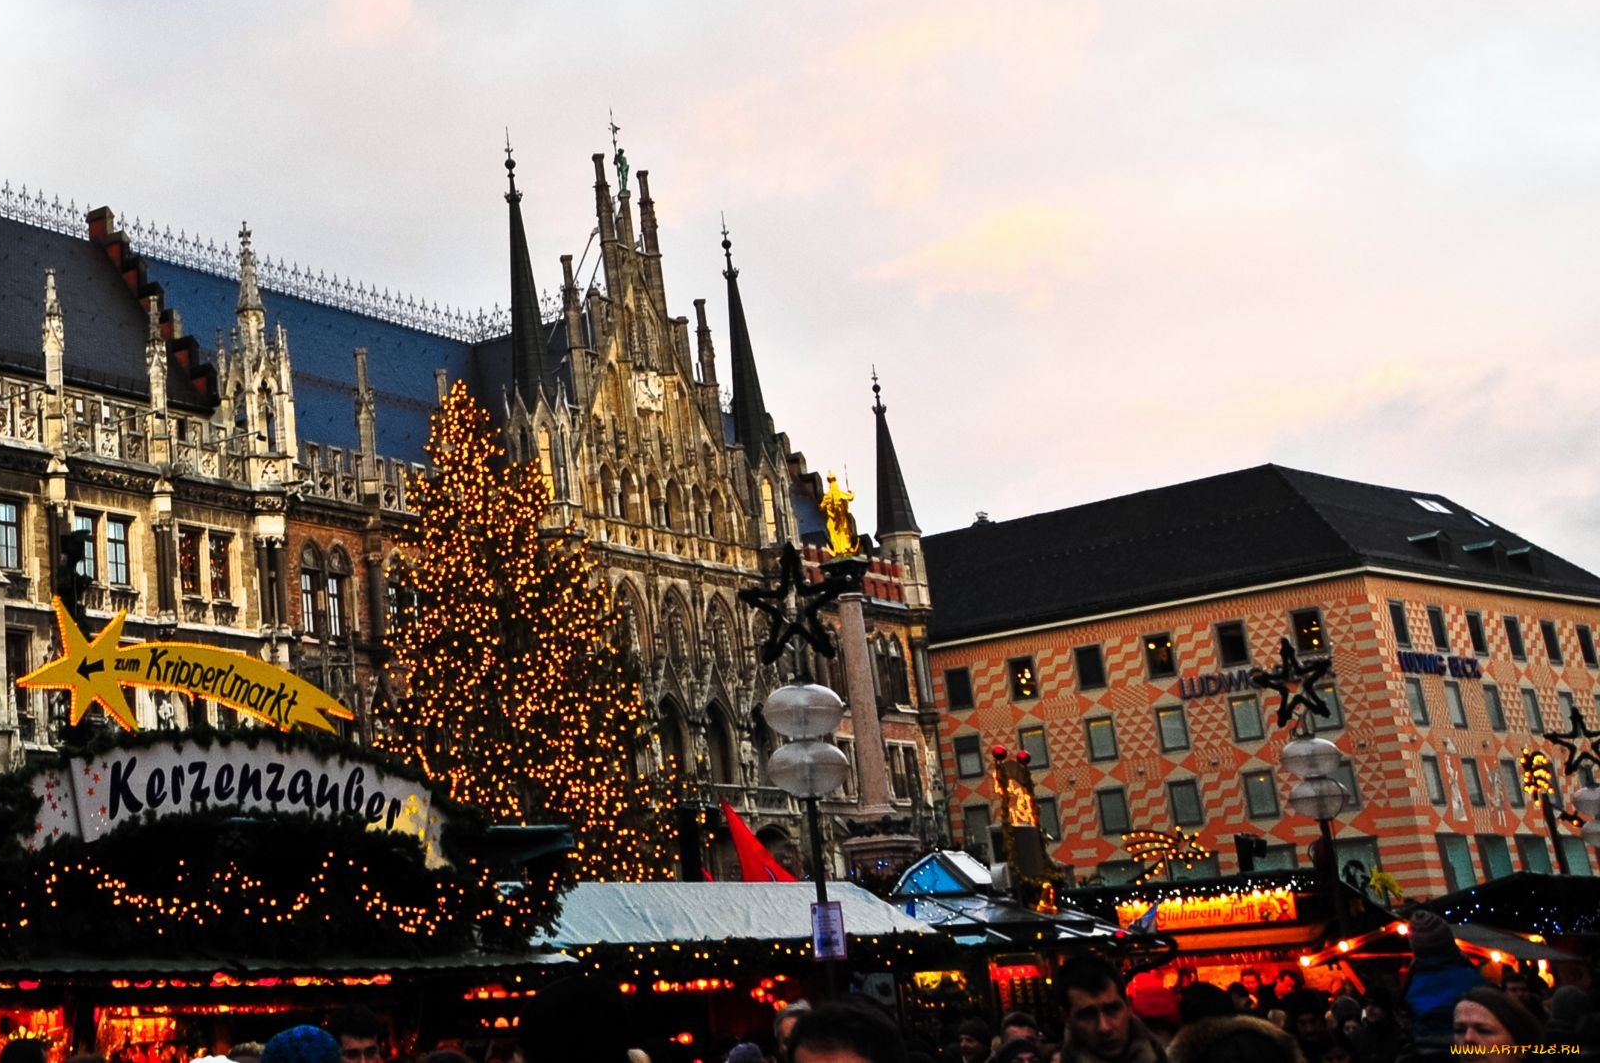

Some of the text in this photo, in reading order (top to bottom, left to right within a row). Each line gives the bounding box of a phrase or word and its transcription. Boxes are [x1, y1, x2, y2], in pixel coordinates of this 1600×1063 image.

[114, 647, 298, 725] zum Kripperlmarkt
[108, 756, 402, 830] Kerzenzauber
[1225, 900, 1255, 922] Treff
